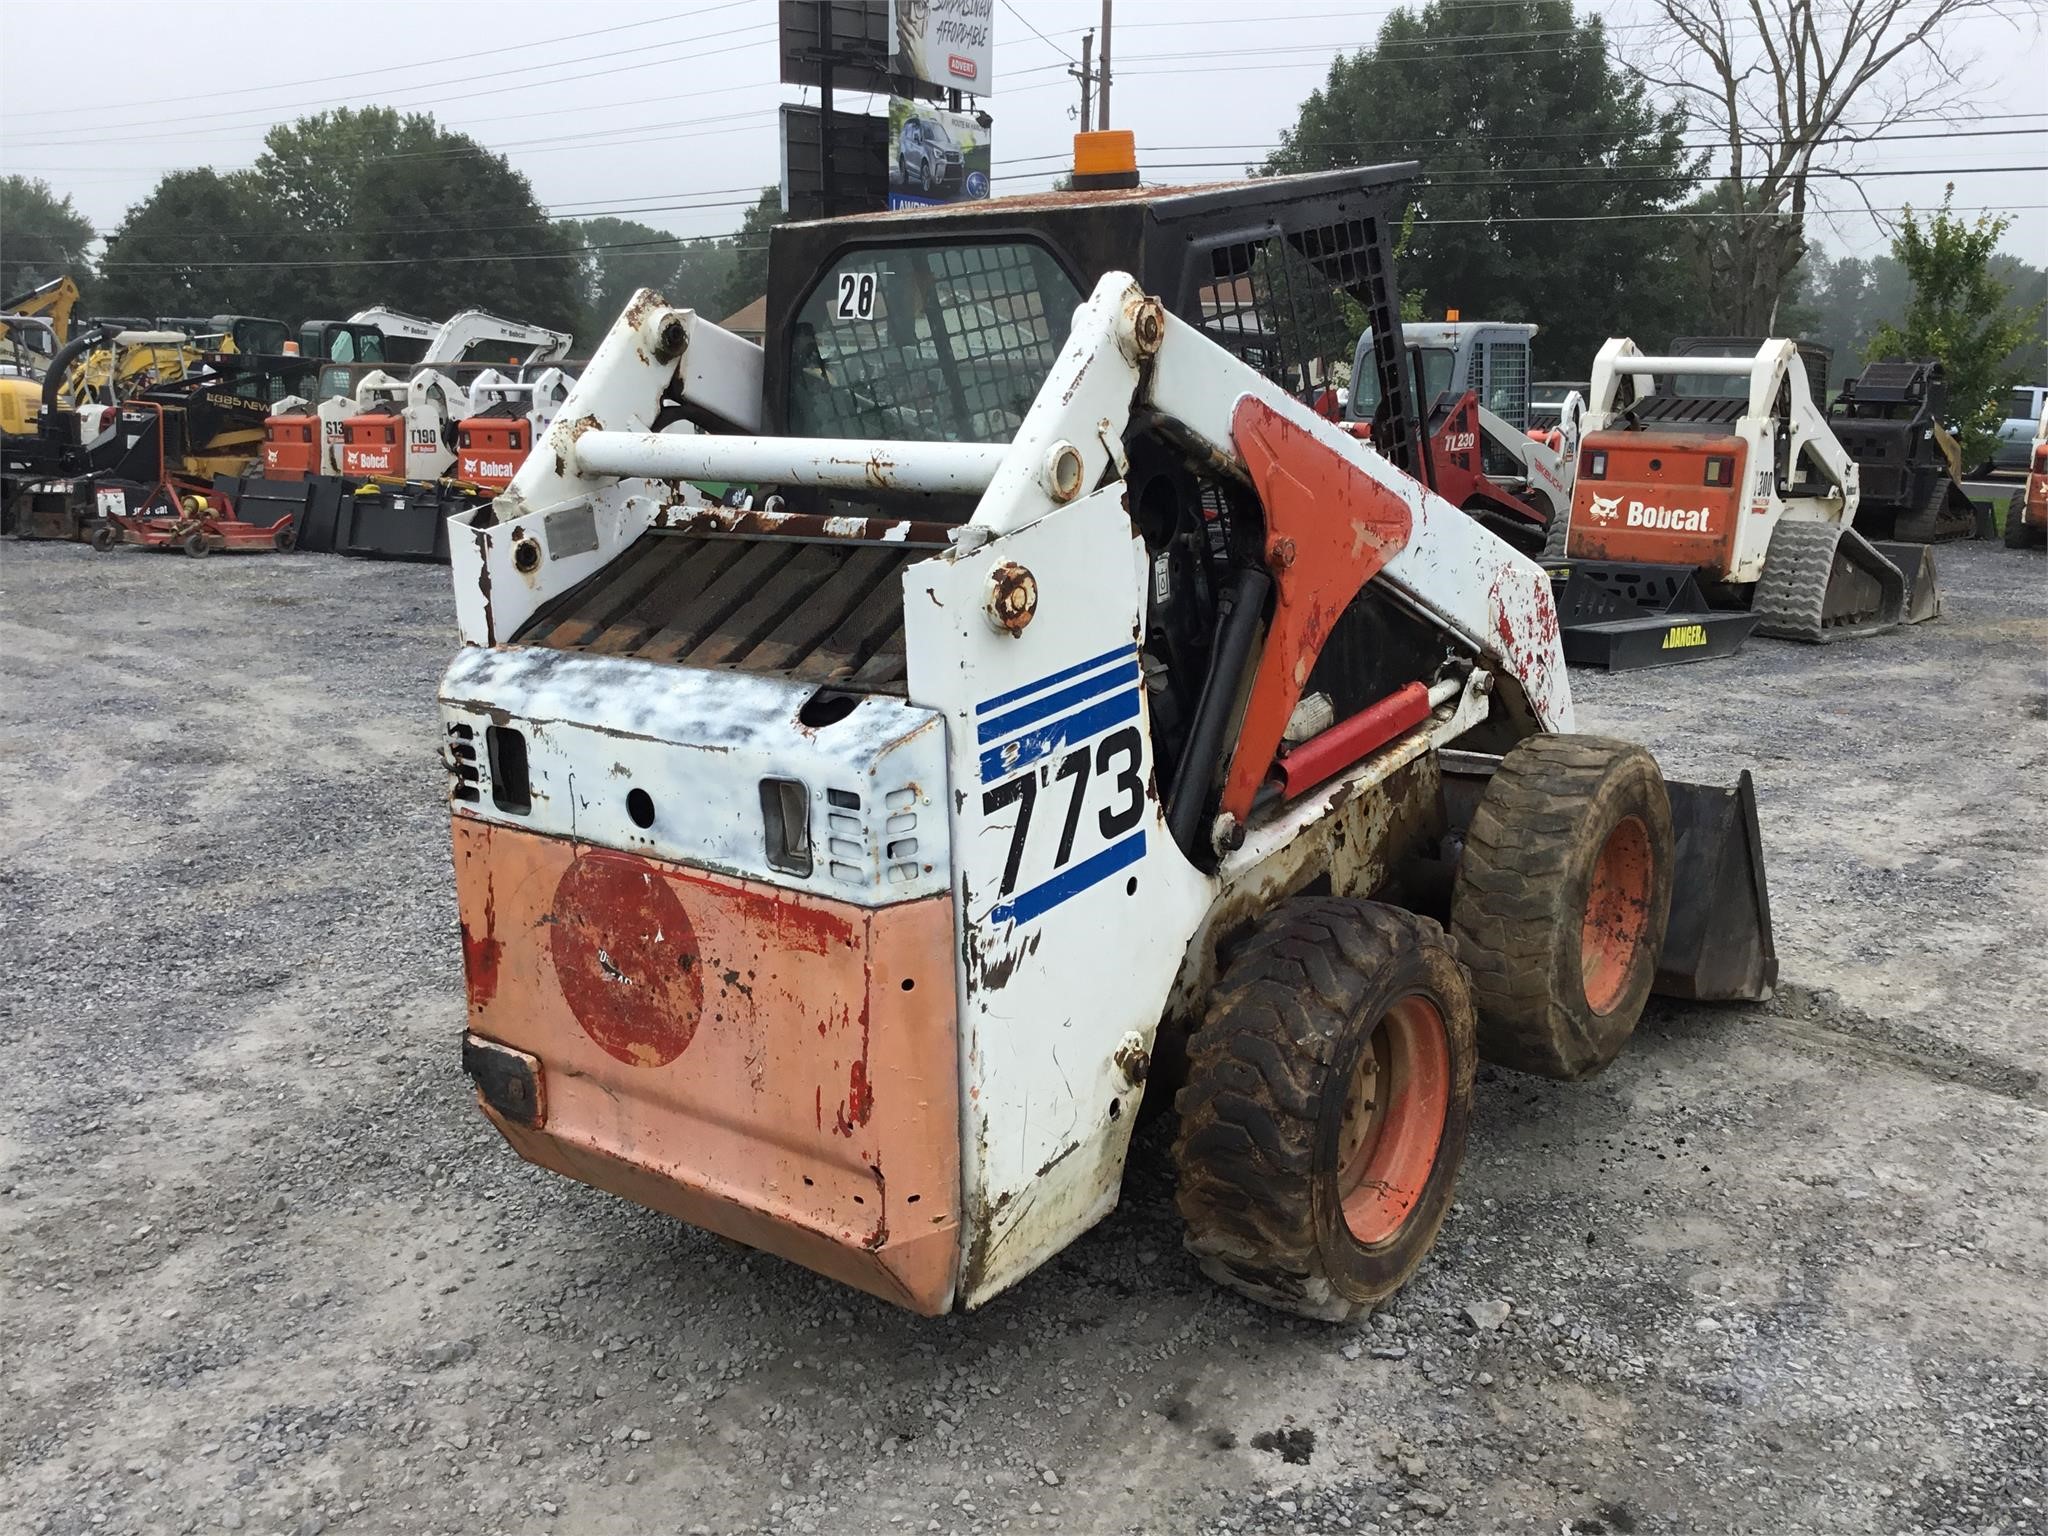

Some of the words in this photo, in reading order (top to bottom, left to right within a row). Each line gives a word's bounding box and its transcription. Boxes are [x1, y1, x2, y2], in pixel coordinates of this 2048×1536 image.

[936, 21, 988, 48] AFFORDABLE
[951, 60, 973, 73] ADVERT
[840, 275, 874, 317] 28
[410, 429, 437, 443] T190
[1445, 433, 1475, 451] TL230
[360, 453, 388, 469] Bobcat
[480, 461, 513, 477] Bobcat
[1627, 501, 1710, 532] Bobcat
[1669, 625, 1702, 648] DANGER
[982, 726, 1145, 900] 773
